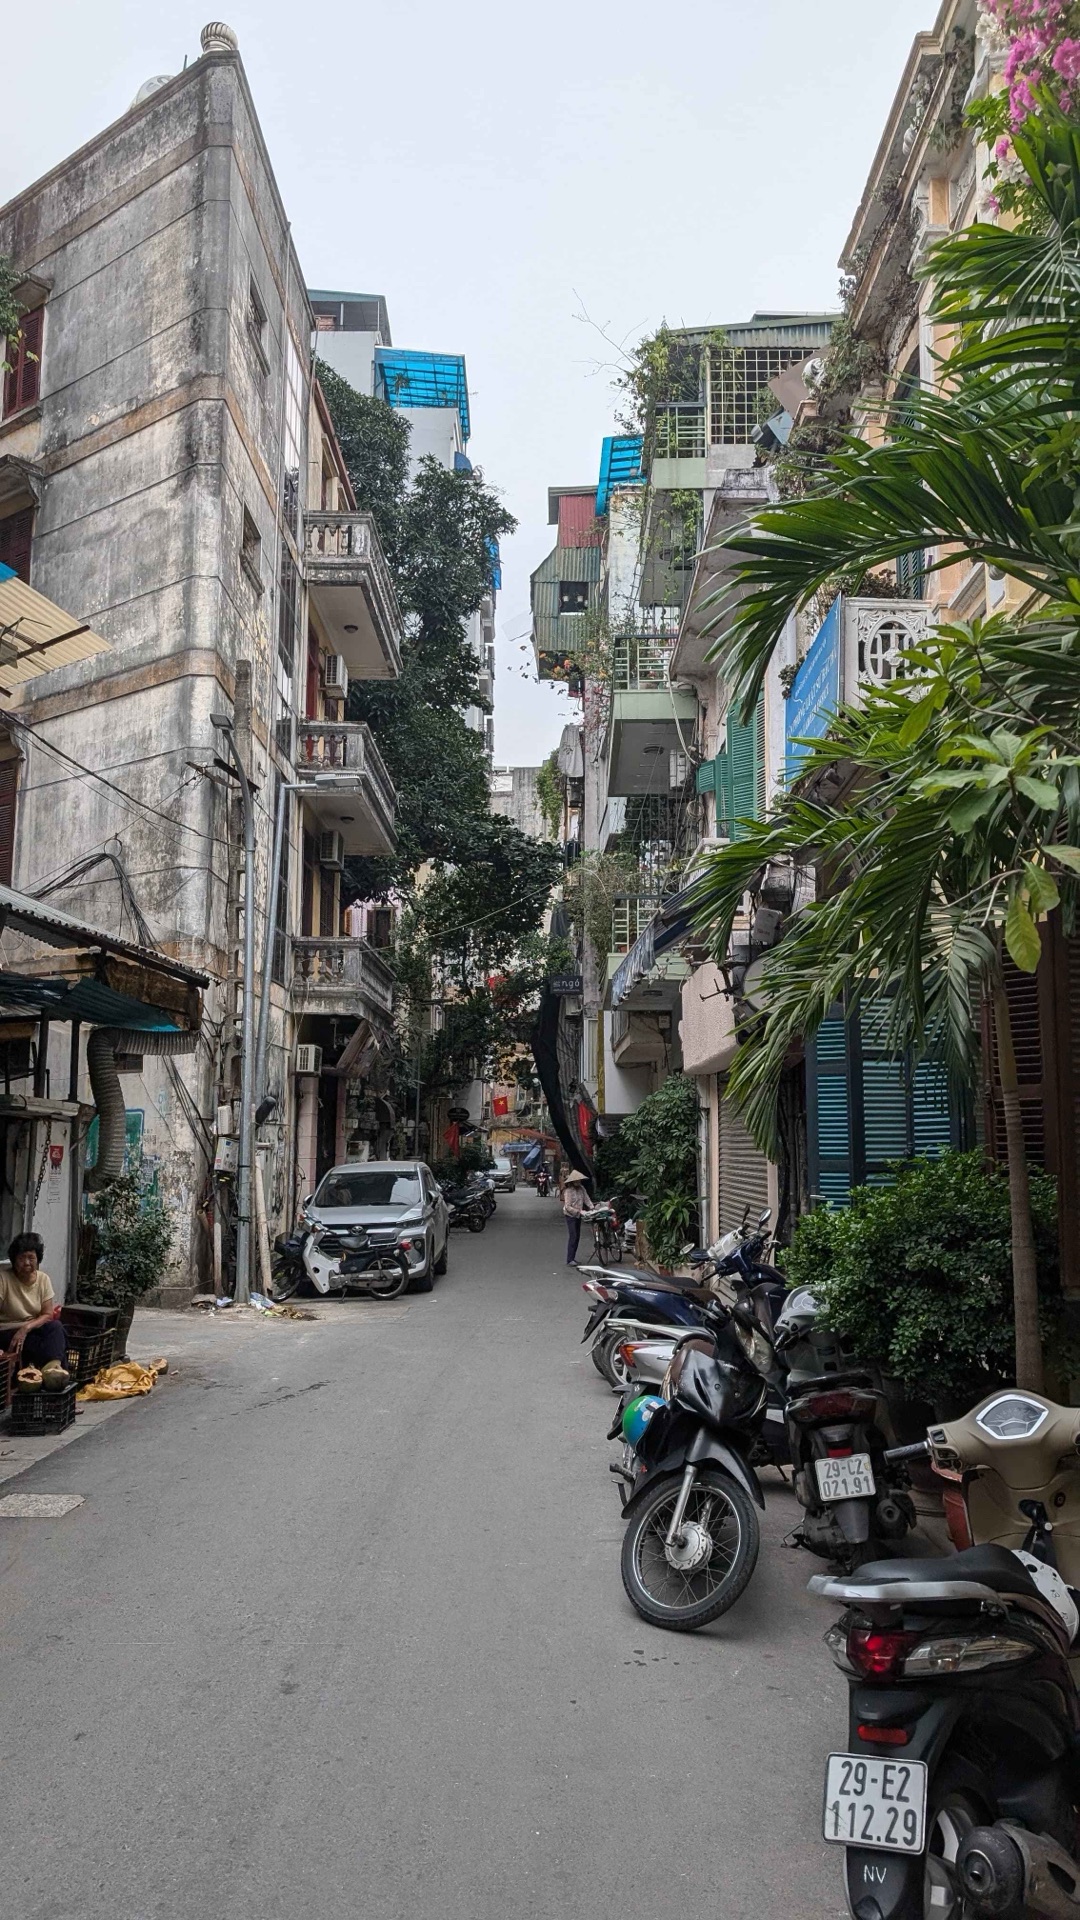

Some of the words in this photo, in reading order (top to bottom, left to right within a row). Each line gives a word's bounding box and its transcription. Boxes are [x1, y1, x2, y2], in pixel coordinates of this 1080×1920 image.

[824, 1458, 864, 1479] 29-C2
[822, 1475, 871, 1498] 021.91
[838, 1761, 911, 1803] 29-E2
[832, 1800, 917, 1847] 112.29
[863, 1864, 887, 1884] NV
